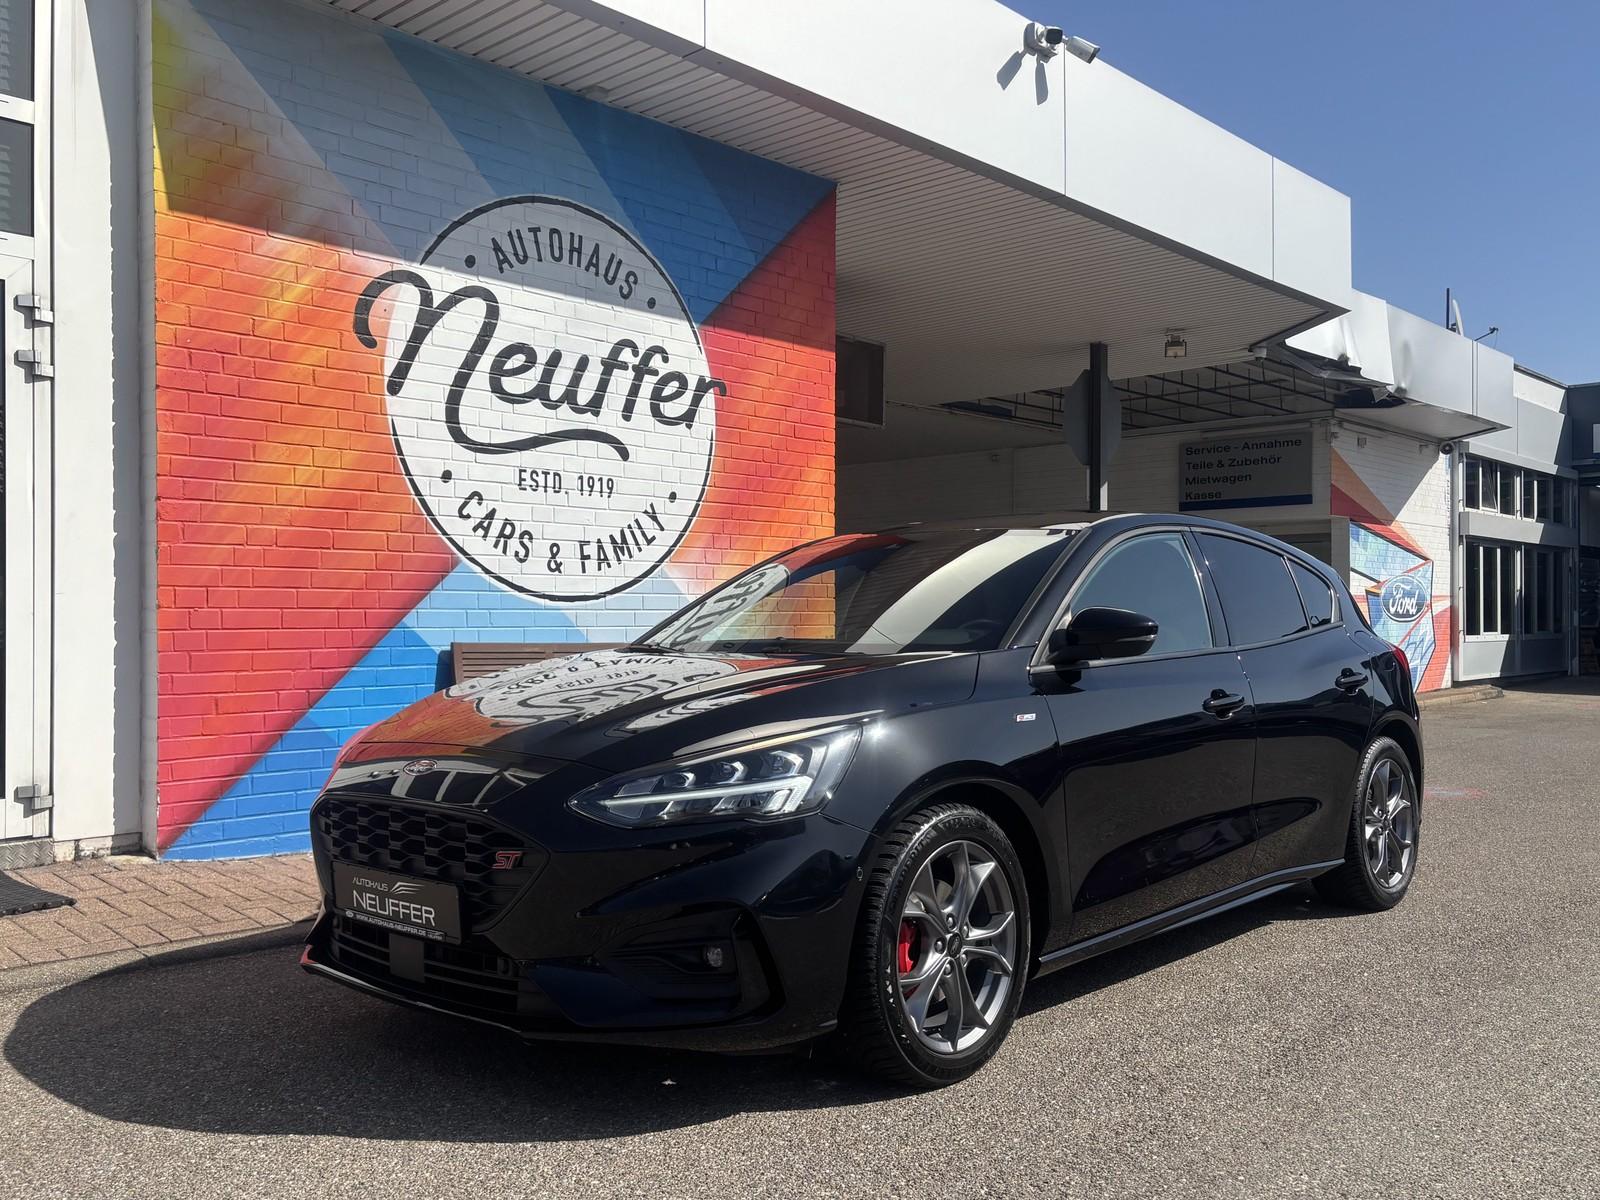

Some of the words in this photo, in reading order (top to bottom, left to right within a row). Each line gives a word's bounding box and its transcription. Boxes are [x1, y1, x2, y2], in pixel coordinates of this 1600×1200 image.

[491, 226, 639, 301] AUTOHAUS
[353, 269, 727, 462] Neuffer
[1185, 445, 1231, 456] Service
[1242, 438, 1302, 451] Annahme
[1186, 460, 1215, 471] Teile
[1216, 459, 1225, 469] &
[1228, 454, 1282, 468] Zubehör
[517, 468, 569, 495] ESTD.
[577, 475, 615, 499] 1919
[1185, 473, 1252, 487] Mietwagen
[1185, 490, 1223, 501] Kasse
[457, 490, 535, 564] CARS
[547, 542, 564, 575] &
[578, 502, 666, 574] FAMILY
[1389, 582, 1419, 616] Ford
[492, 850, 523, 870] ST
[352, 876, 389, 893] AUTOHAUS
[352, 889, 436, 927] NEUFFER
